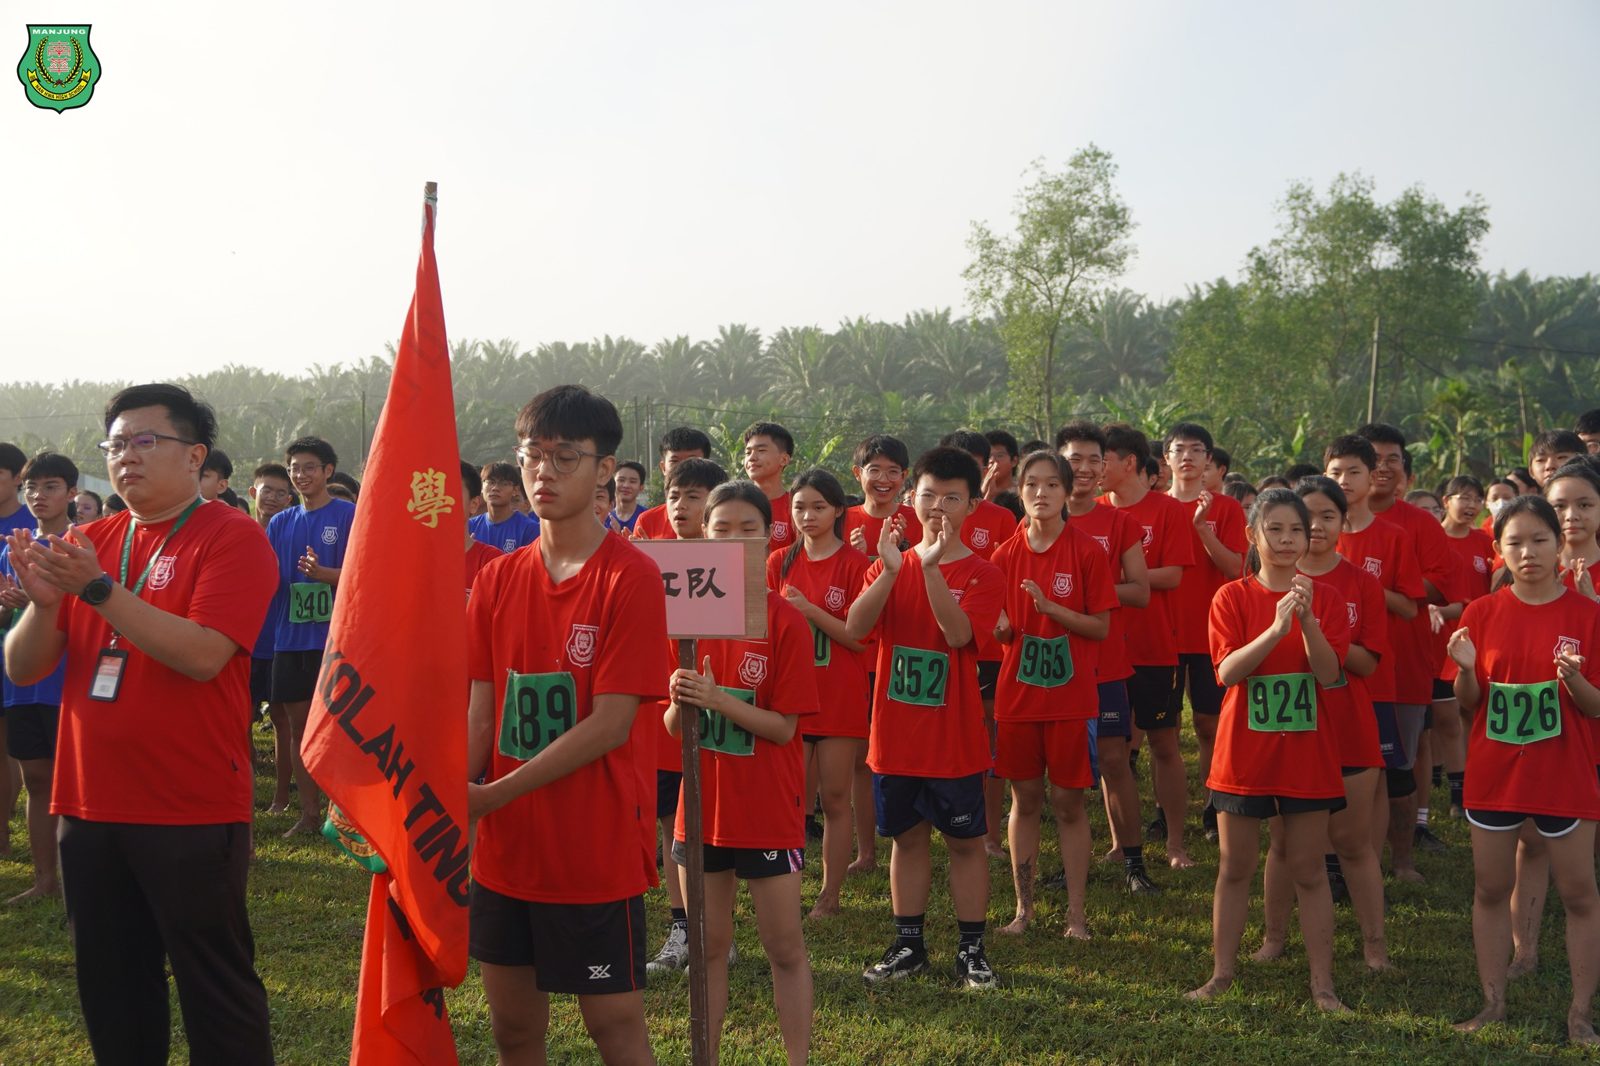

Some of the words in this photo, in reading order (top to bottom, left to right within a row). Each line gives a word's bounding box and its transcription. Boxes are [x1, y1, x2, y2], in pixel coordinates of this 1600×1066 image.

[407, 467, 455, 528] 學
[295, 591, 329, 618] 340
[894, 655, 944, 698] 952
[1023, 641, 1066, 679] 965
[1253, 679, 1312, 724] 924
[1490, 687, 1557, 736] 926
